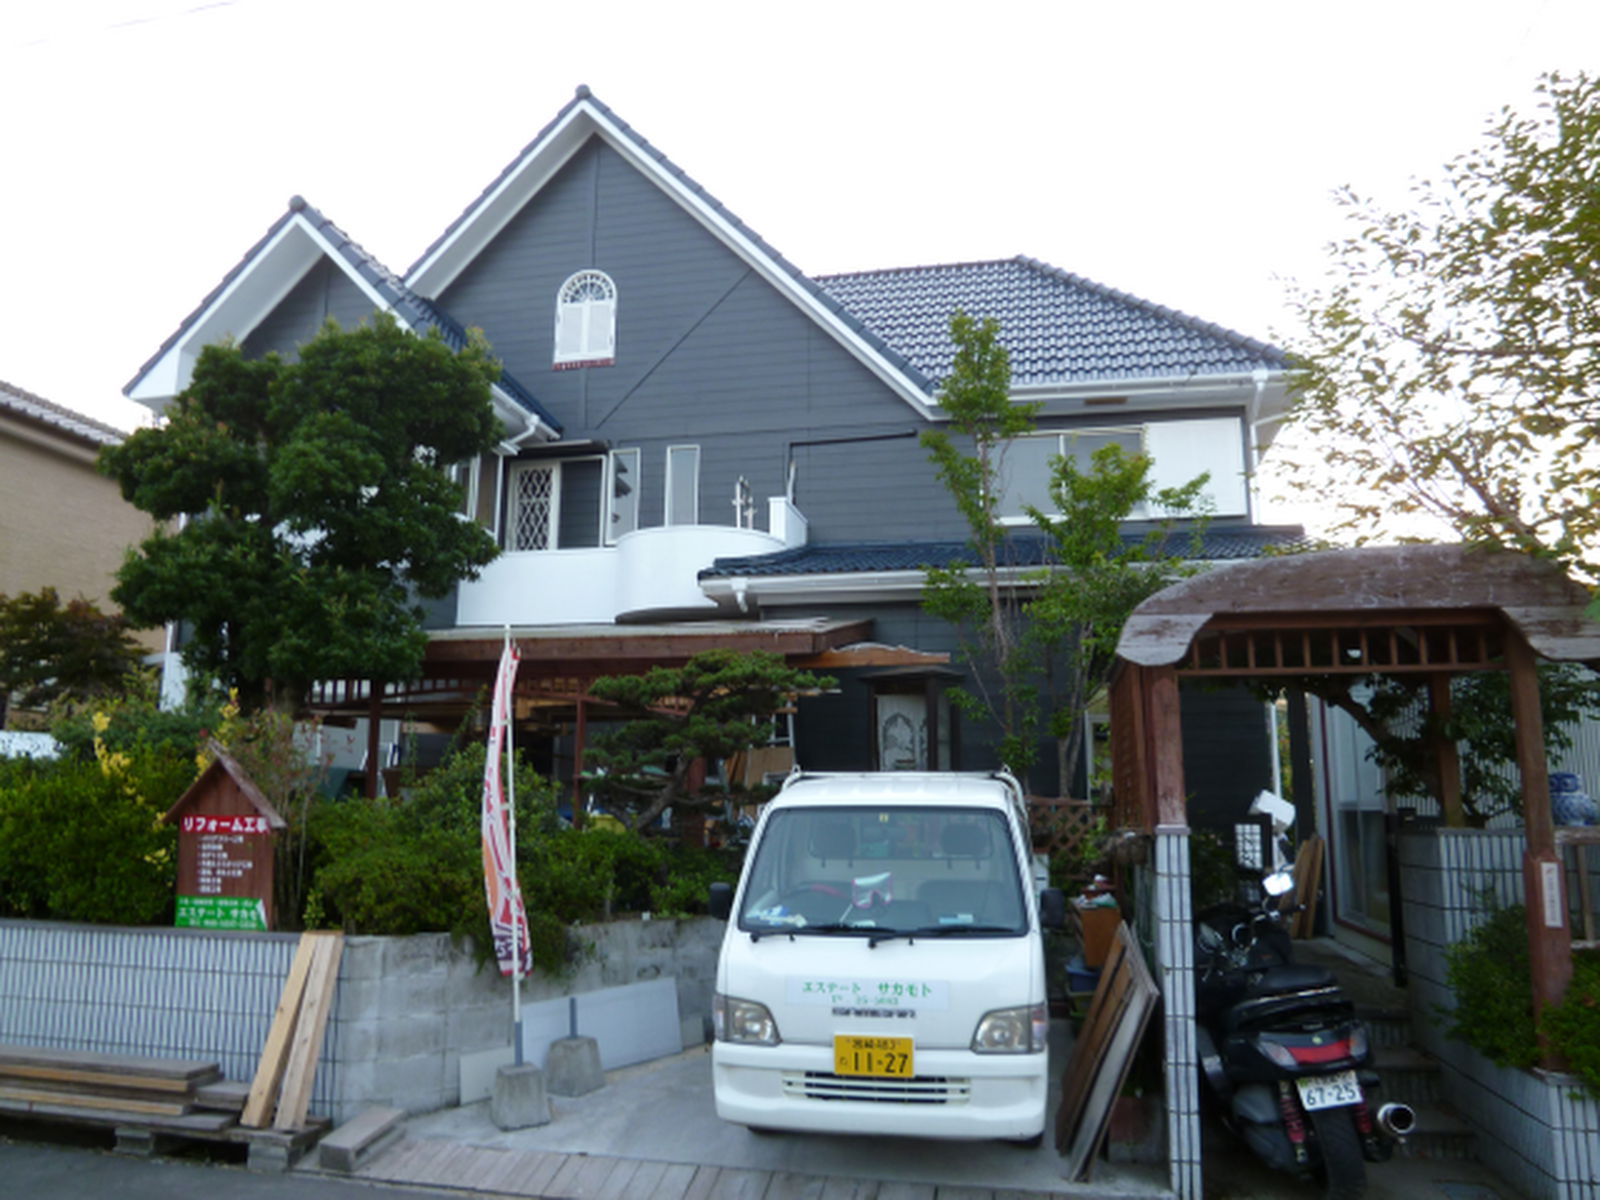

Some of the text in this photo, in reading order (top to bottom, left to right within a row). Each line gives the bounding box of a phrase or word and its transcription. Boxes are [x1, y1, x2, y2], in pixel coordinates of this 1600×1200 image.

[802, 981, 932, 997] エステート サカモト
[854, 1051, 908, 1074] 11-27
[1306, 1081, 1356, 1106] 67-25
